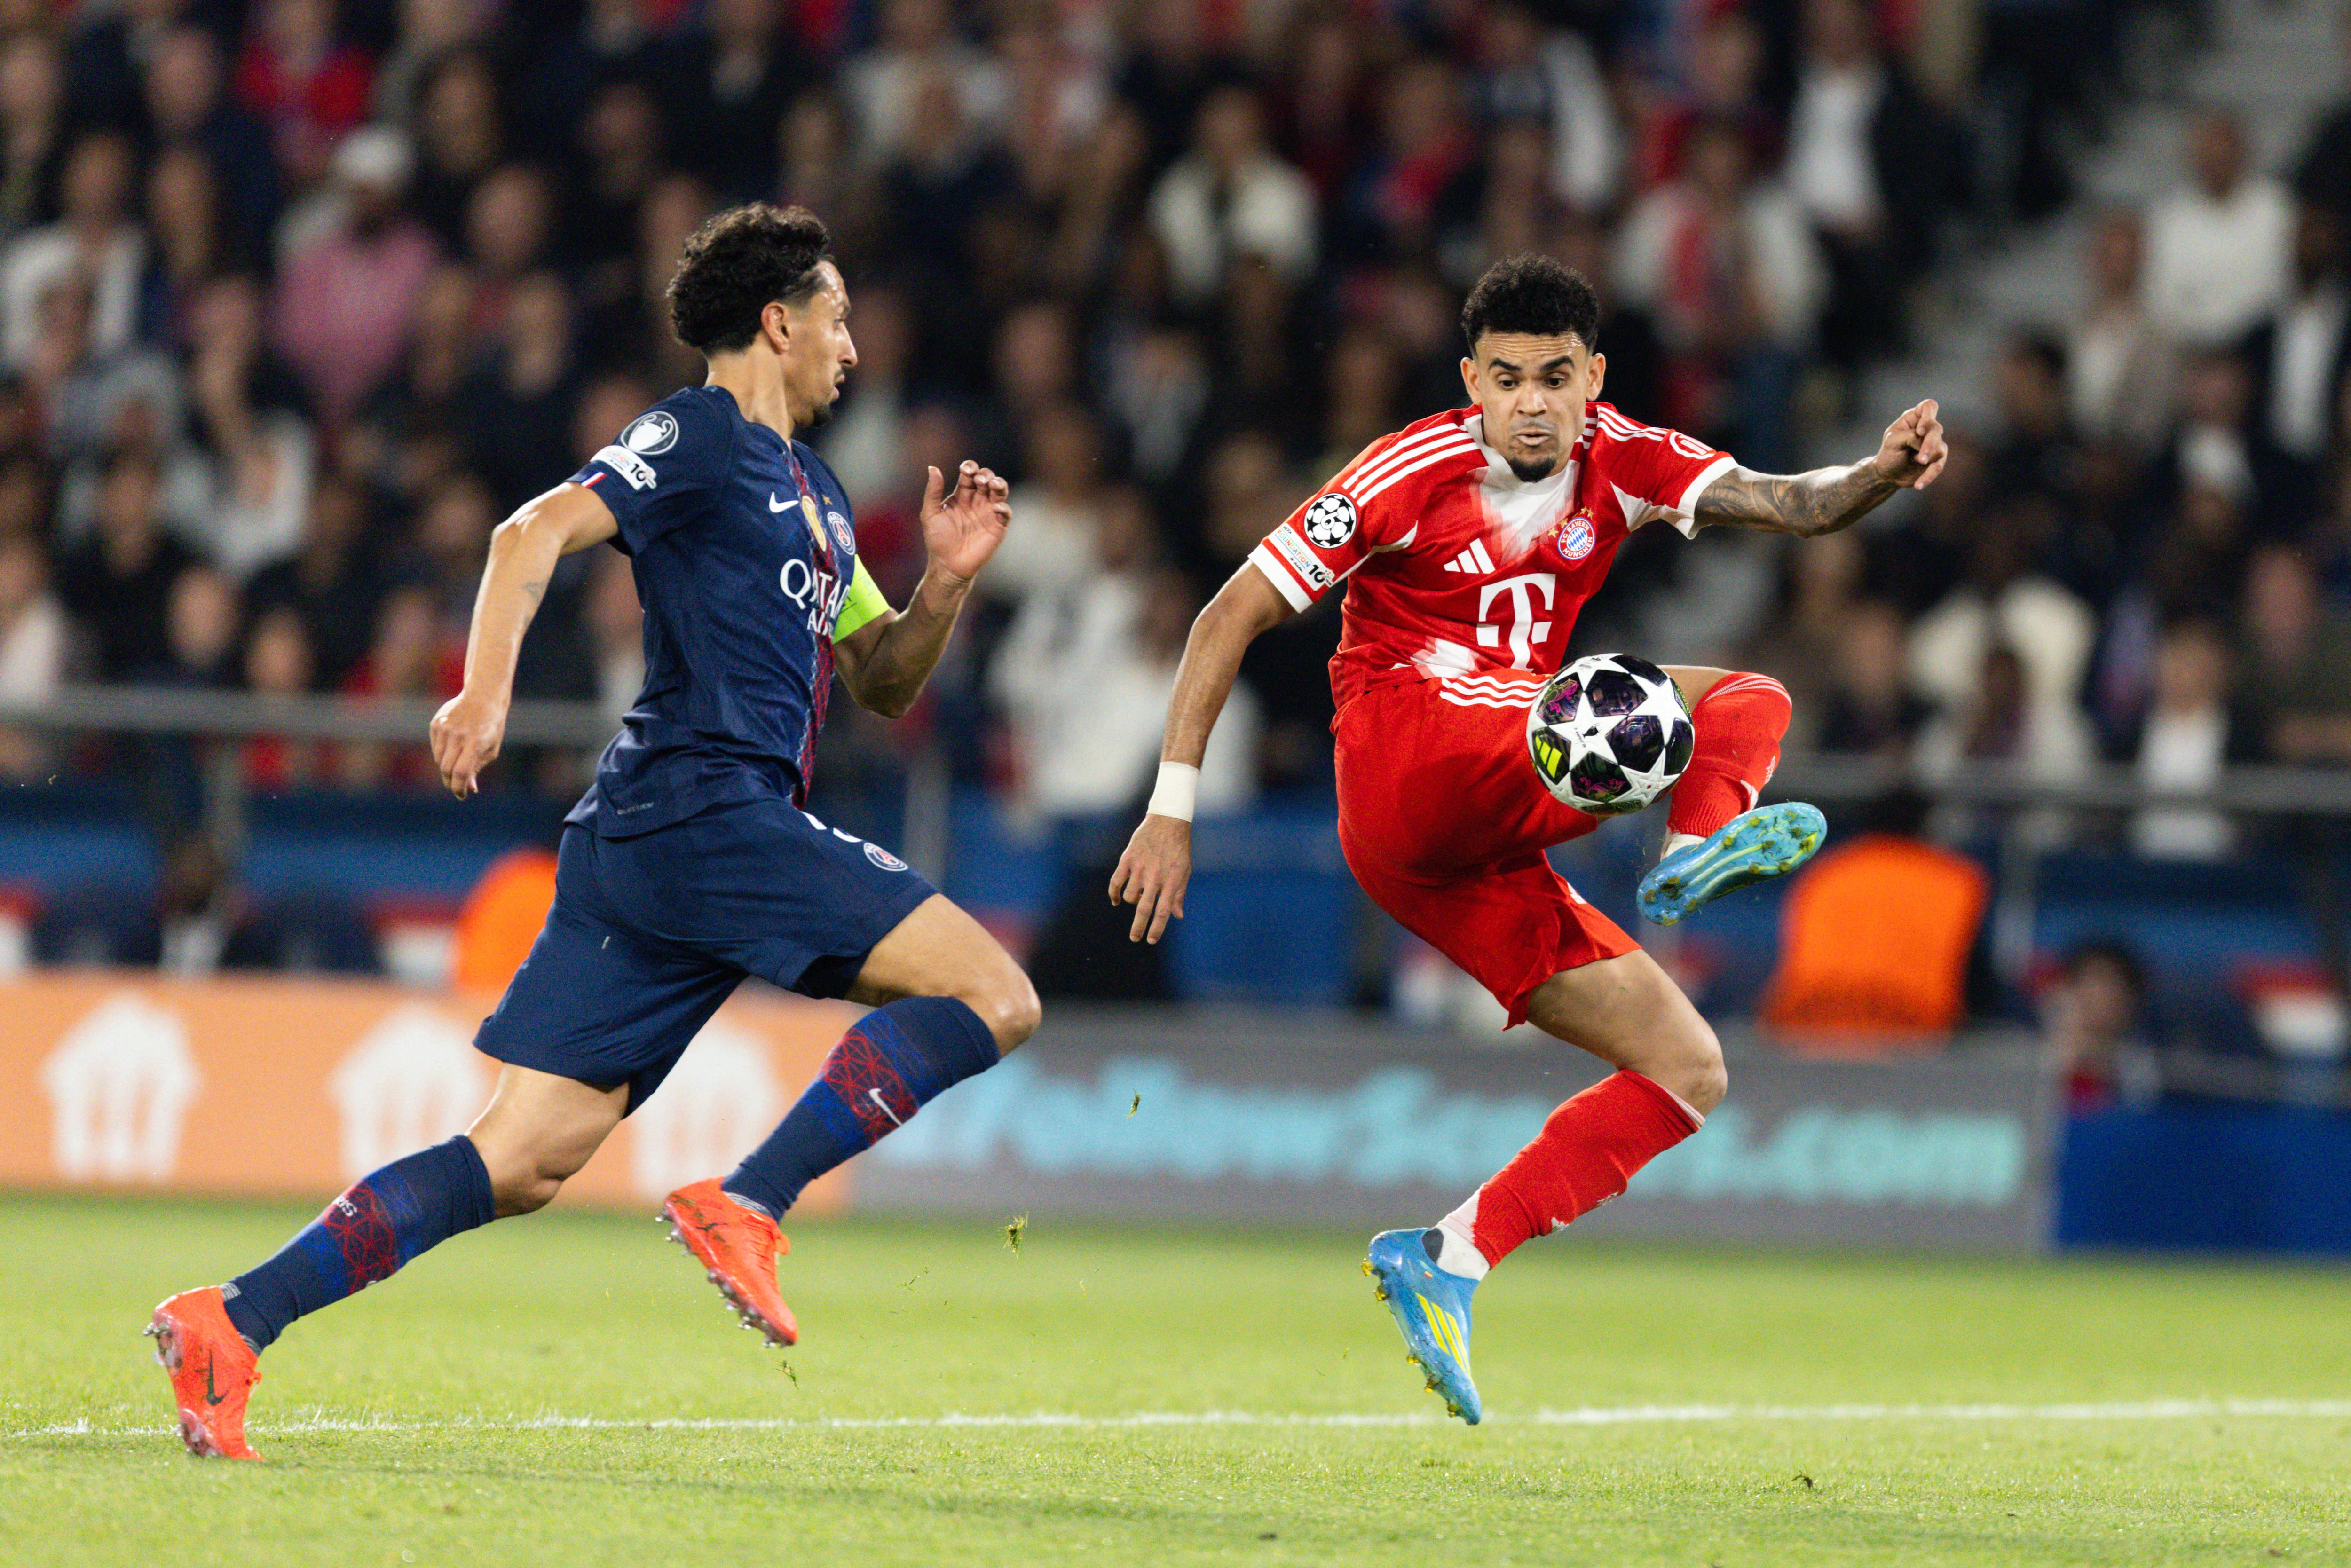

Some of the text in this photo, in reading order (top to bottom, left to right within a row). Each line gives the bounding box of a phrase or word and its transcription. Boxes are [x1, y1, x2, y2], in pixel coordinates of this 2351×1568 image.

[631, 464, 647, 481] 10
[1321, 512, 1340, 530] 6
[1561, 520, 1590, 543] FC BAYERN
[1277, 530, 1310, 568] FOUNDATION
[1308, 564, 1325, 583] 10
[1476, 573, 1556, 672] T
